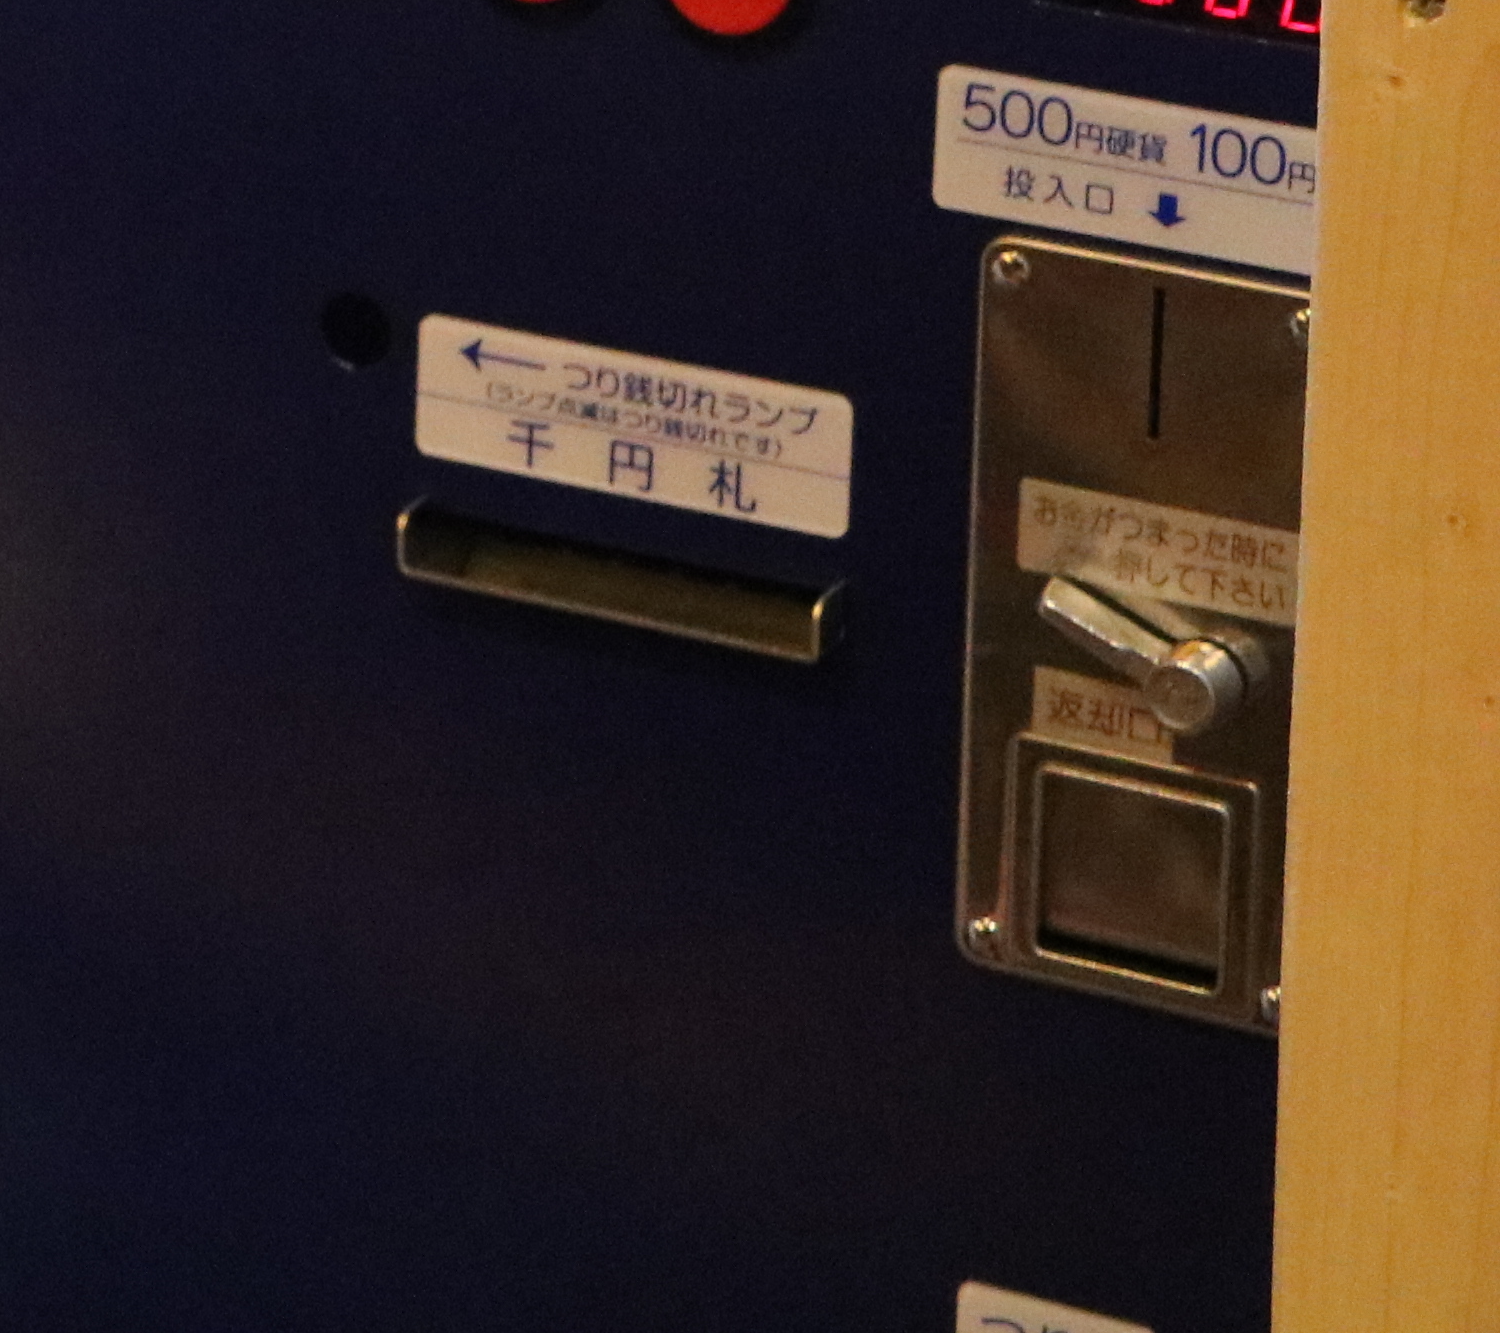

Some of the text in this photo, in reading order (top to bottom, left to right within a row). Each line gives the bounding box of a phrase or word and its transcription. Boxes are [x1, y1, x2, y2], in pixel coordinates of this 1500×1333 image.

[961, 81, 1317, 195] 500円硬貨 100円
[1003, 164, 1115, 216] 投入口
[562, 362, 818, 435] つり銭切れランプ
